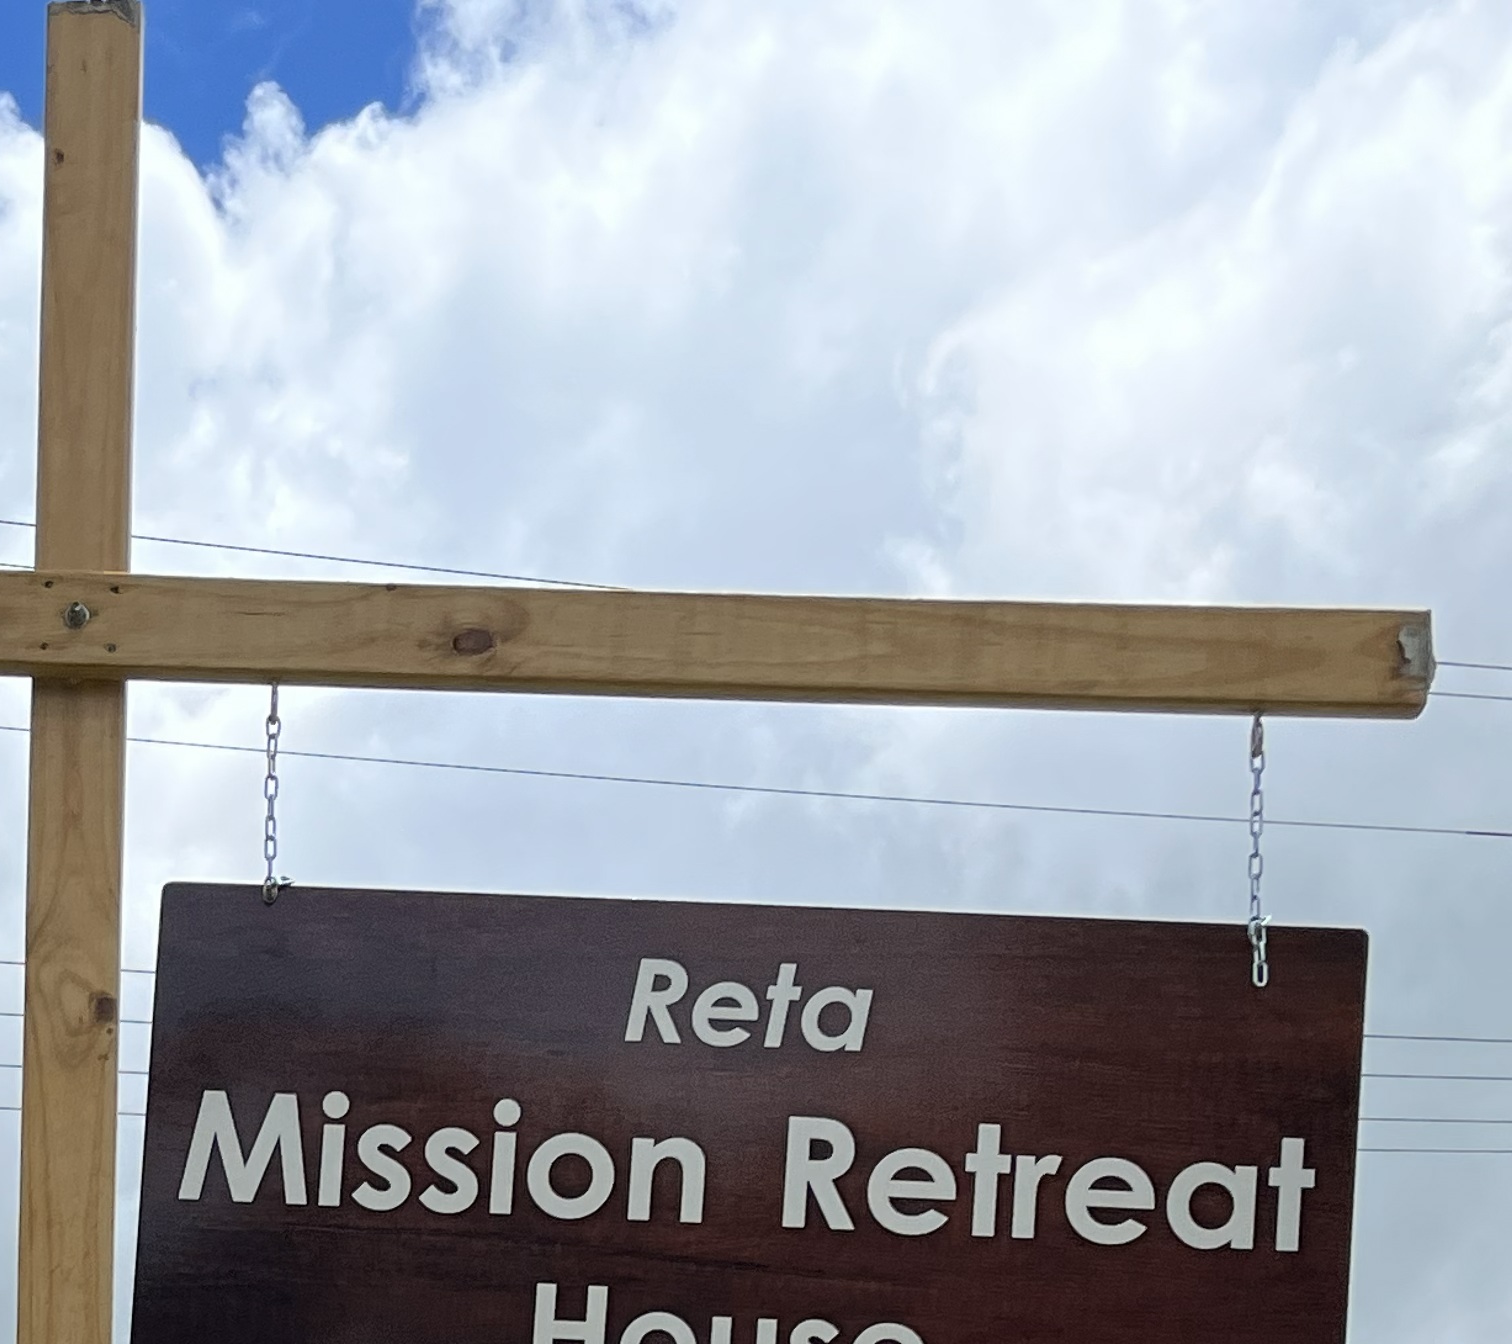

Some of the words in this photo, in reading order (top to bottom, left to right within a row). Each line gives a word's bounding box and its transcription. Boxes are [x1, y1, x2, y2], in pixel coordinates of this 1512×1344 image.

[623, 956, 875, 1053] Reta
[177, 1089, 707, 1225] Mission
[781, 1114, 1317, 1254] Retreat
